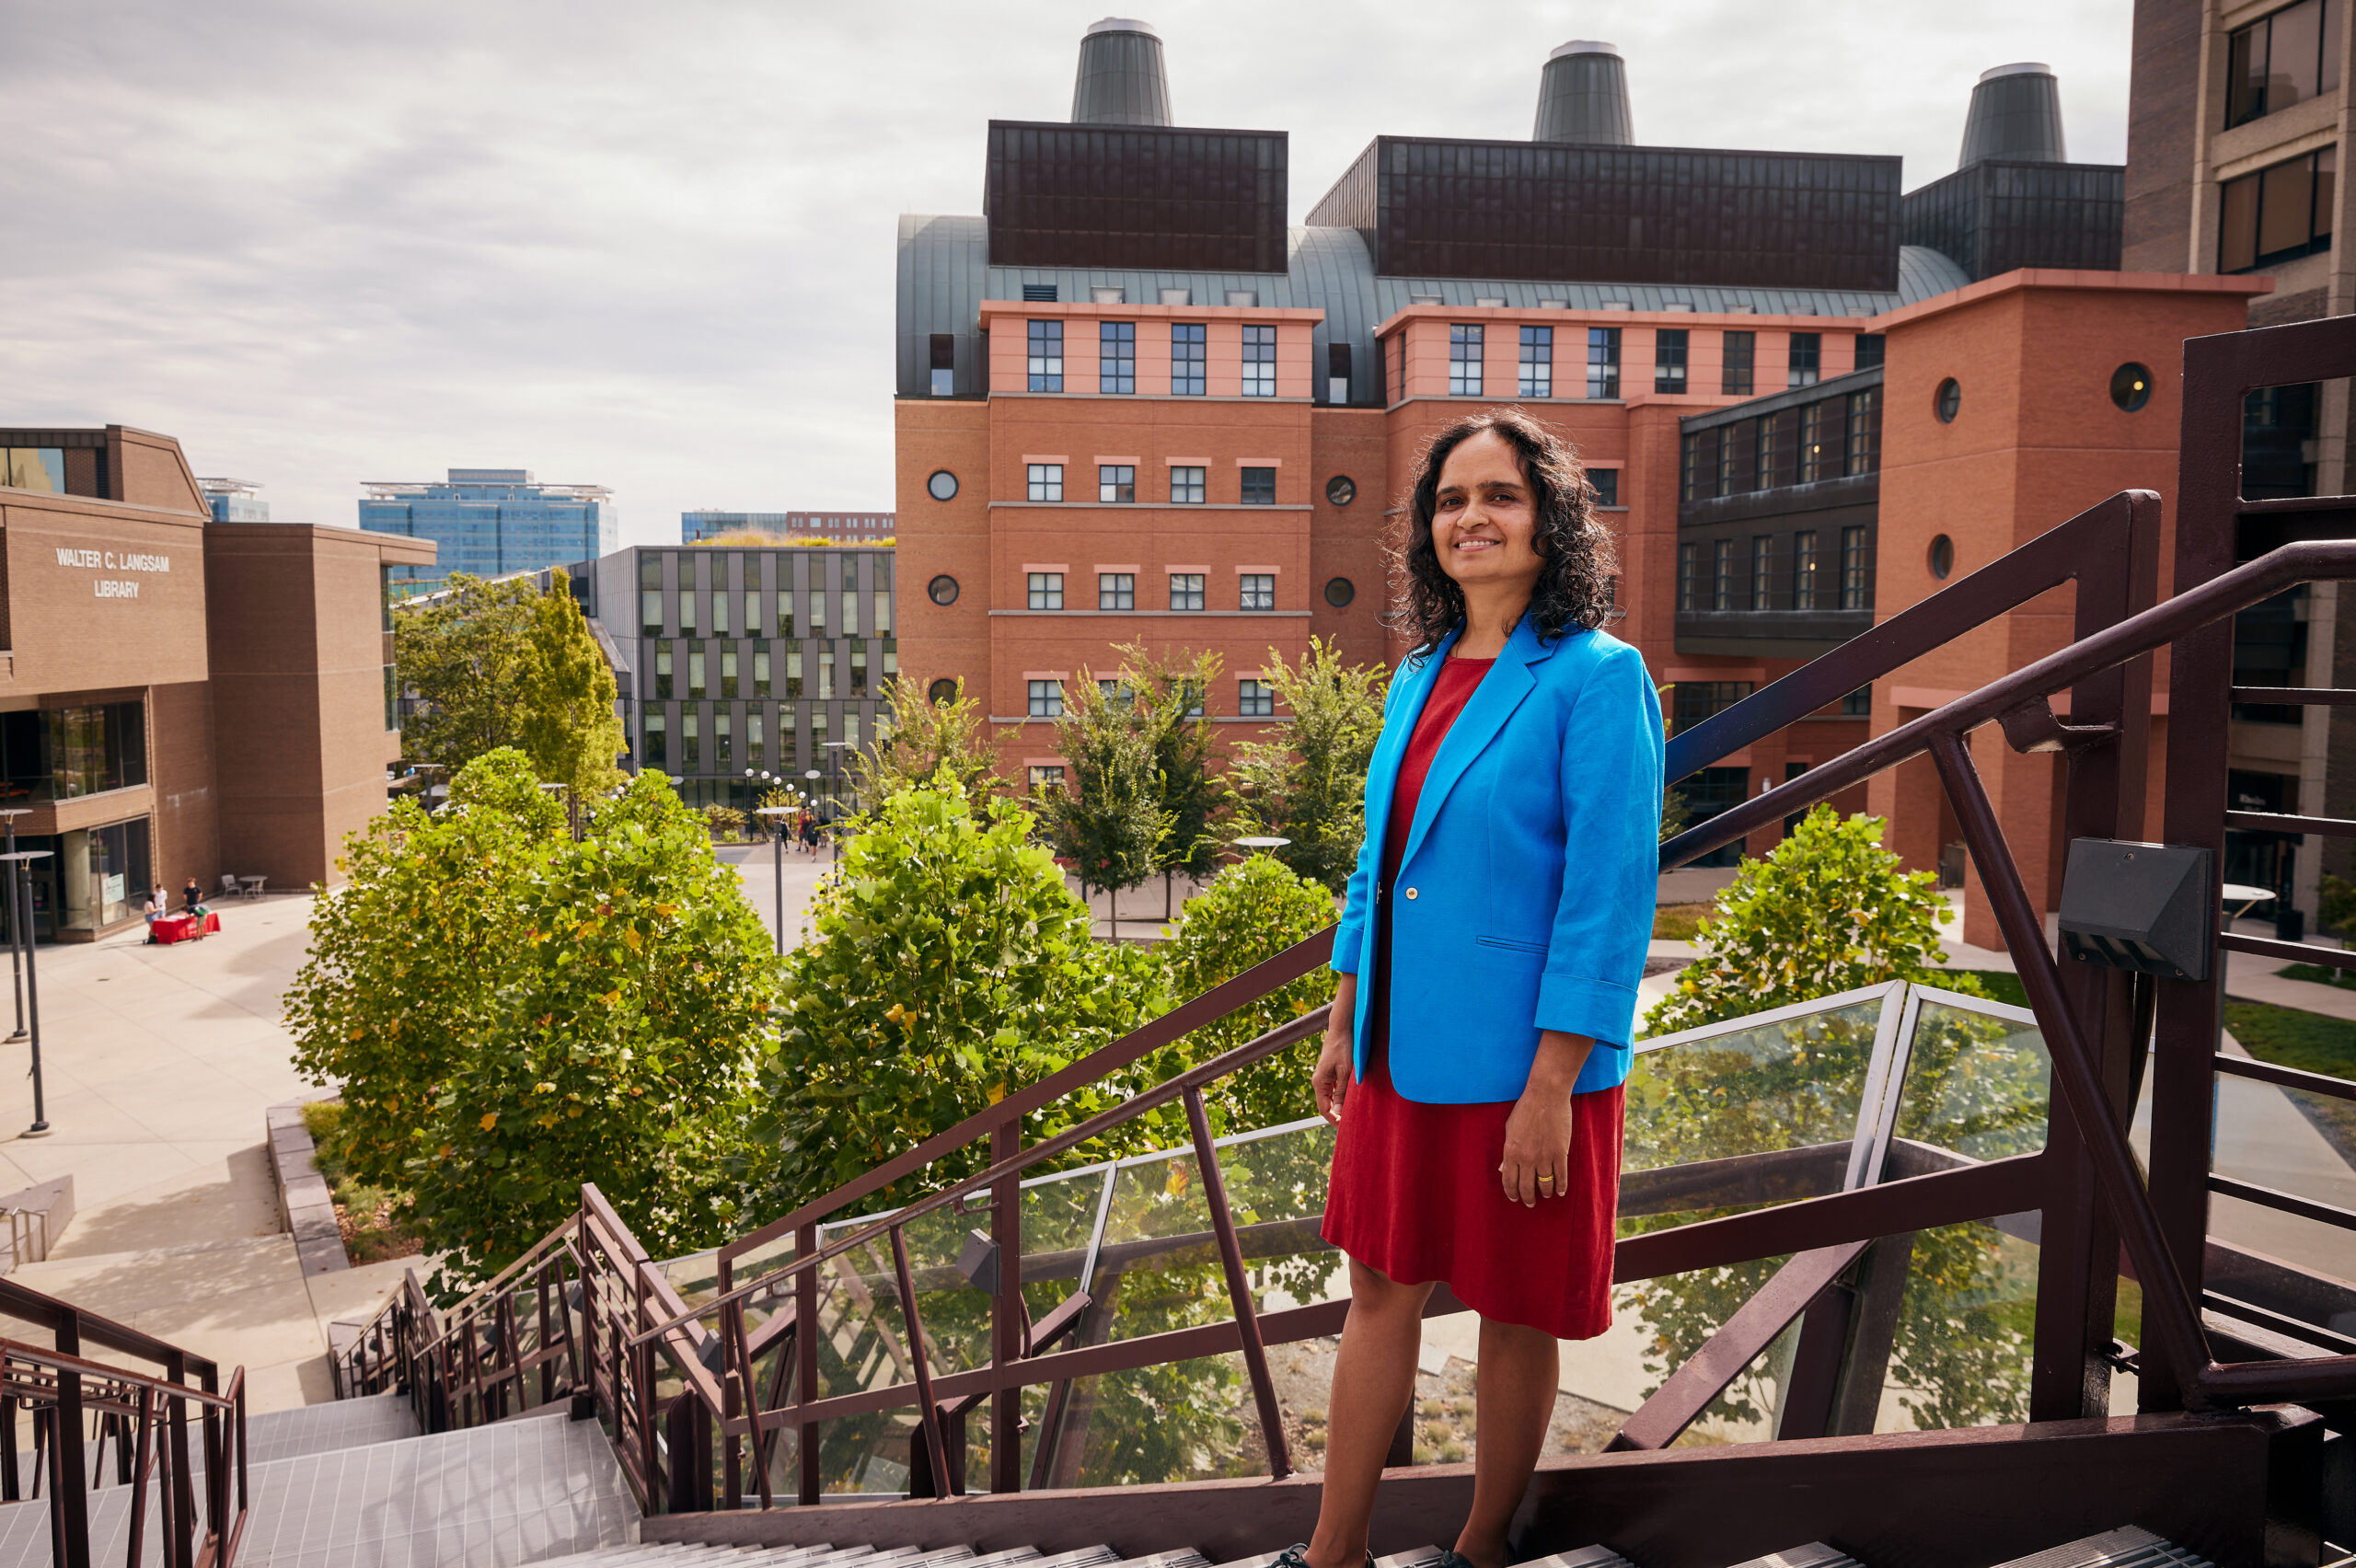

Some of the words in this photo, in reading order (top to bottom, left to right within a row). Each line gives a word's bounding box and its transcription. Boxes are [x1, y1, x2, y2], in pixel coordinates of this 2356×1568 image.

[55, 548, 101, 569] WALTER
[104, 551, 117, 570] C.
[120, 553, 169, 572] LANGSAM
[94, 580, 139, 598] LIBRARY
